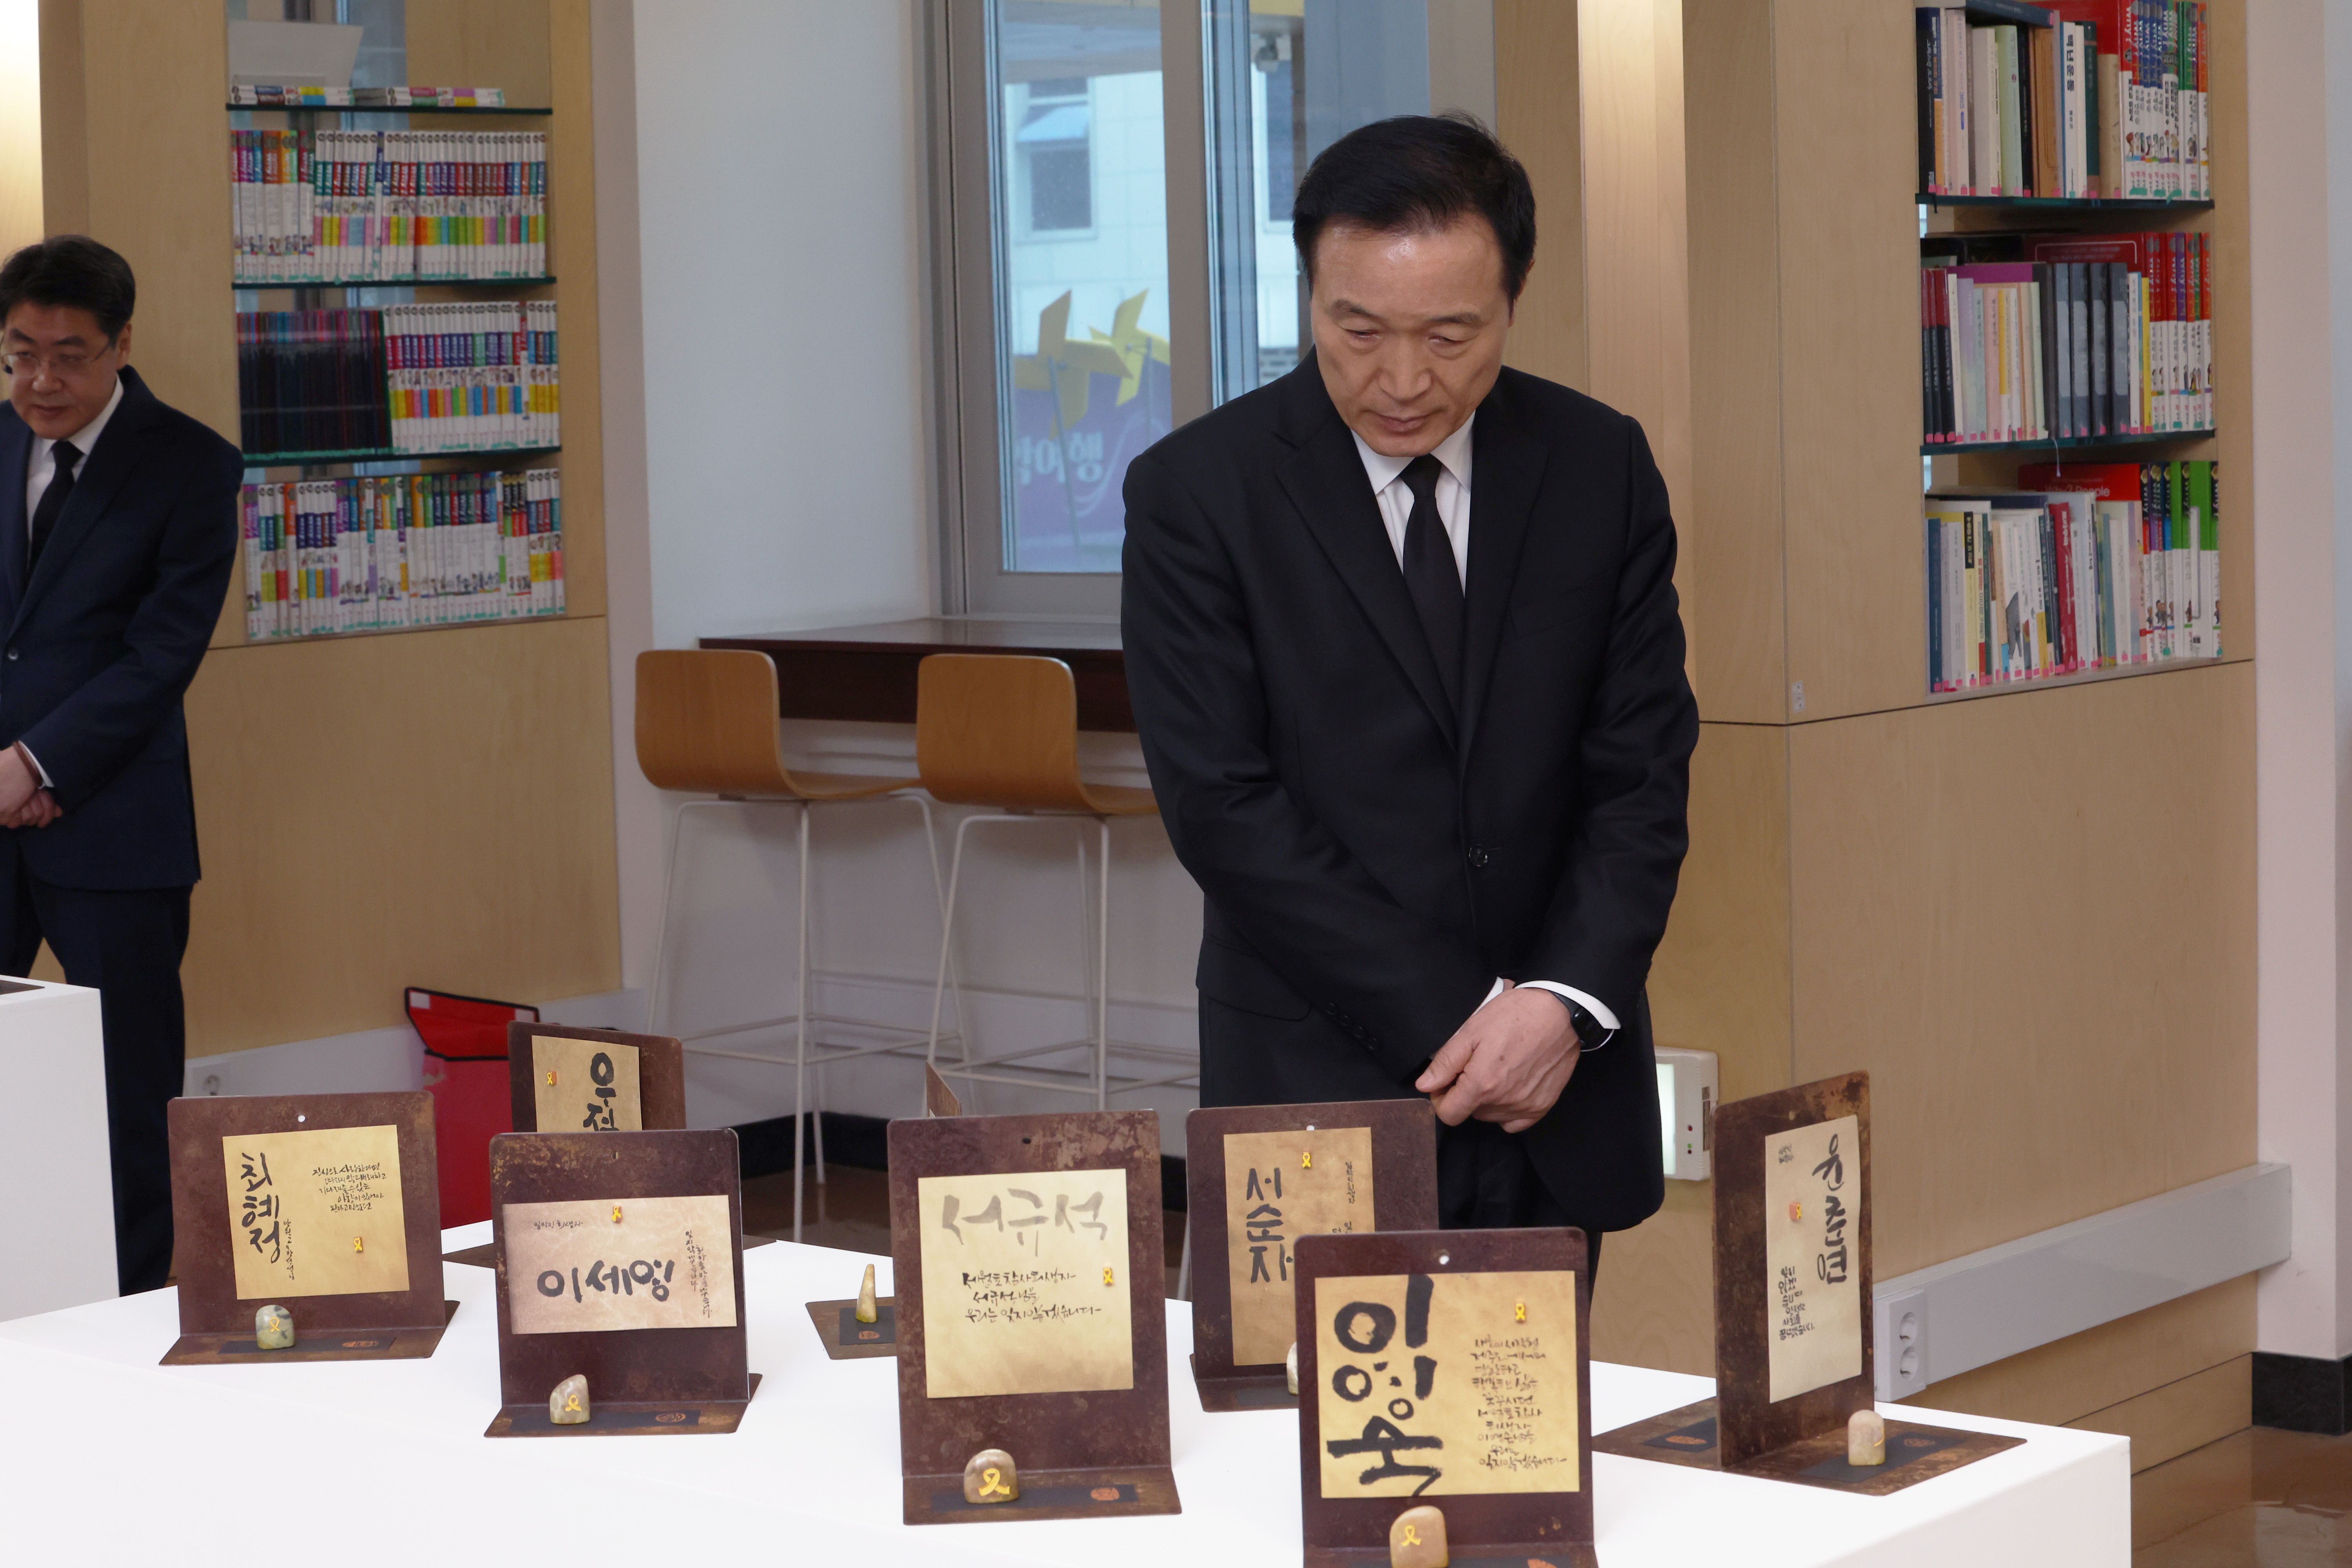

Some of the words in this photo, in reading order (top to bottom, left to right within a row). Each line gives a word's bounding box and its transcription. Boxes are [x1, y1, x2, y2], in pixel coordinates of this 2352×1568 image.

[241, 1152, 280, 1264] 최혜정
[942, 1188, 1109, 1257] 서규석
[1246, 1167, 1294, 1283] 서순자
[537, 1259, 675, 1303] 이세영
[1327, 1274, 1443, 1496] 이영숙
